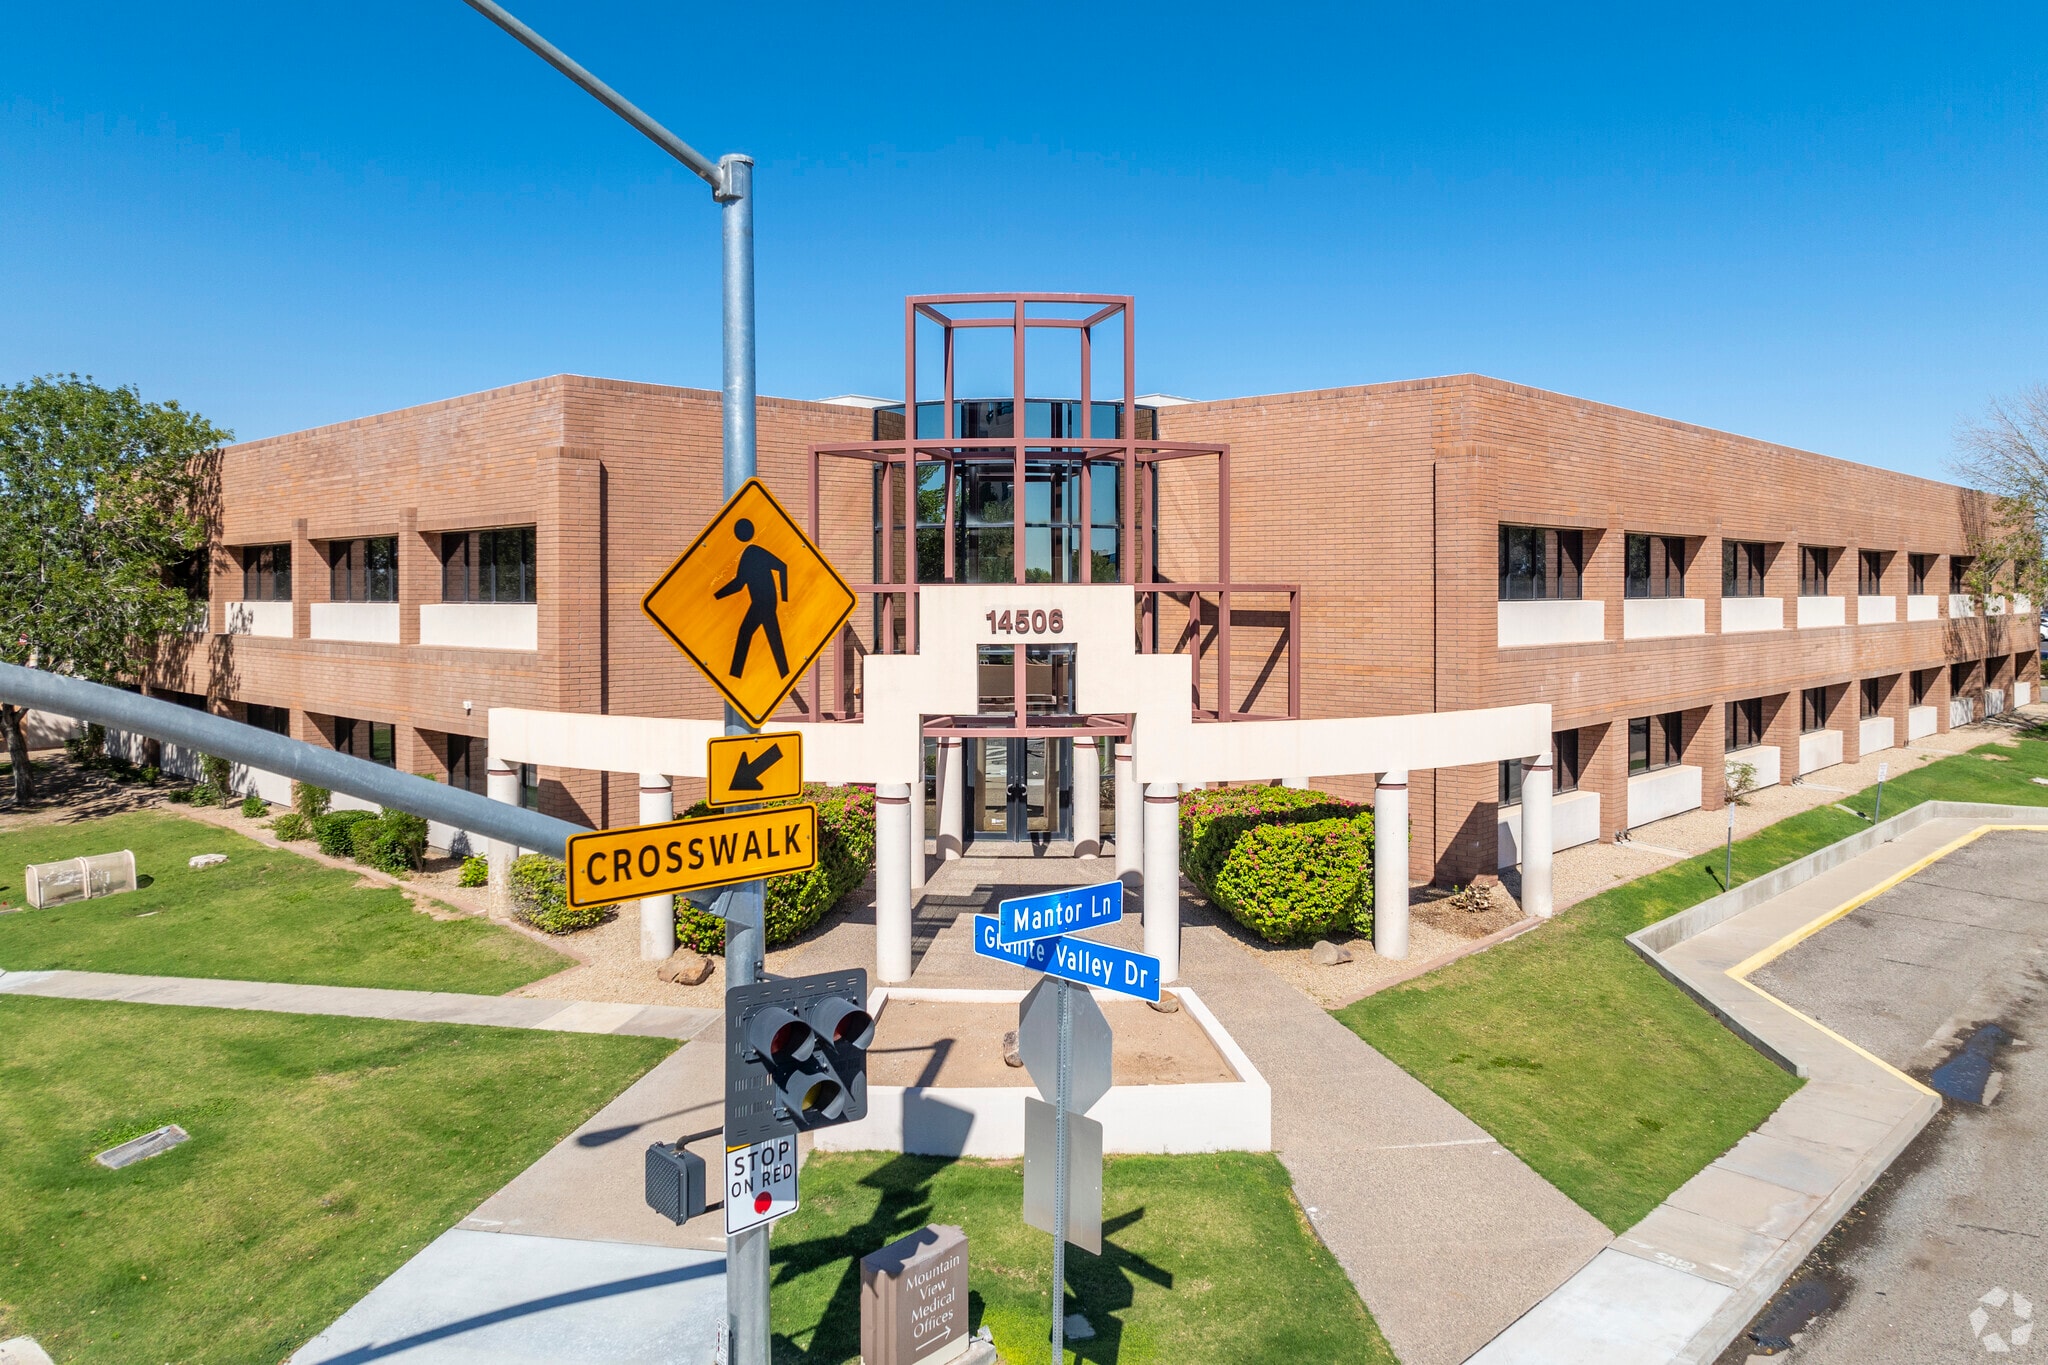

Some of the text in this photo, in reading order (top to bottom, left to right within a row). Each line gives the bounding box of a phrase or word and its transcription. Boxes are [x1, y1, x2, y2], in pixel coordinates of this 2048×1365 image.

[986, 608, 1064, 634] 14506
[586, 823, 802, 886] CROSSWALK
[1014, 895, 1111, 933] Mantor Ln
[1055, 943, 1114, 985] Valley
[1125, 959, 1149, 989] Dr
[734, 1141, 790, 1177] STOP
[731, 1163, 792, 1198] ON RED
[906, 1255, 960, 1292] Mountain
[919, 1278, 948, 1300] View
[911, 1287, 955, 1324] Medical
[913, 1308, 954, 1339] Offices
